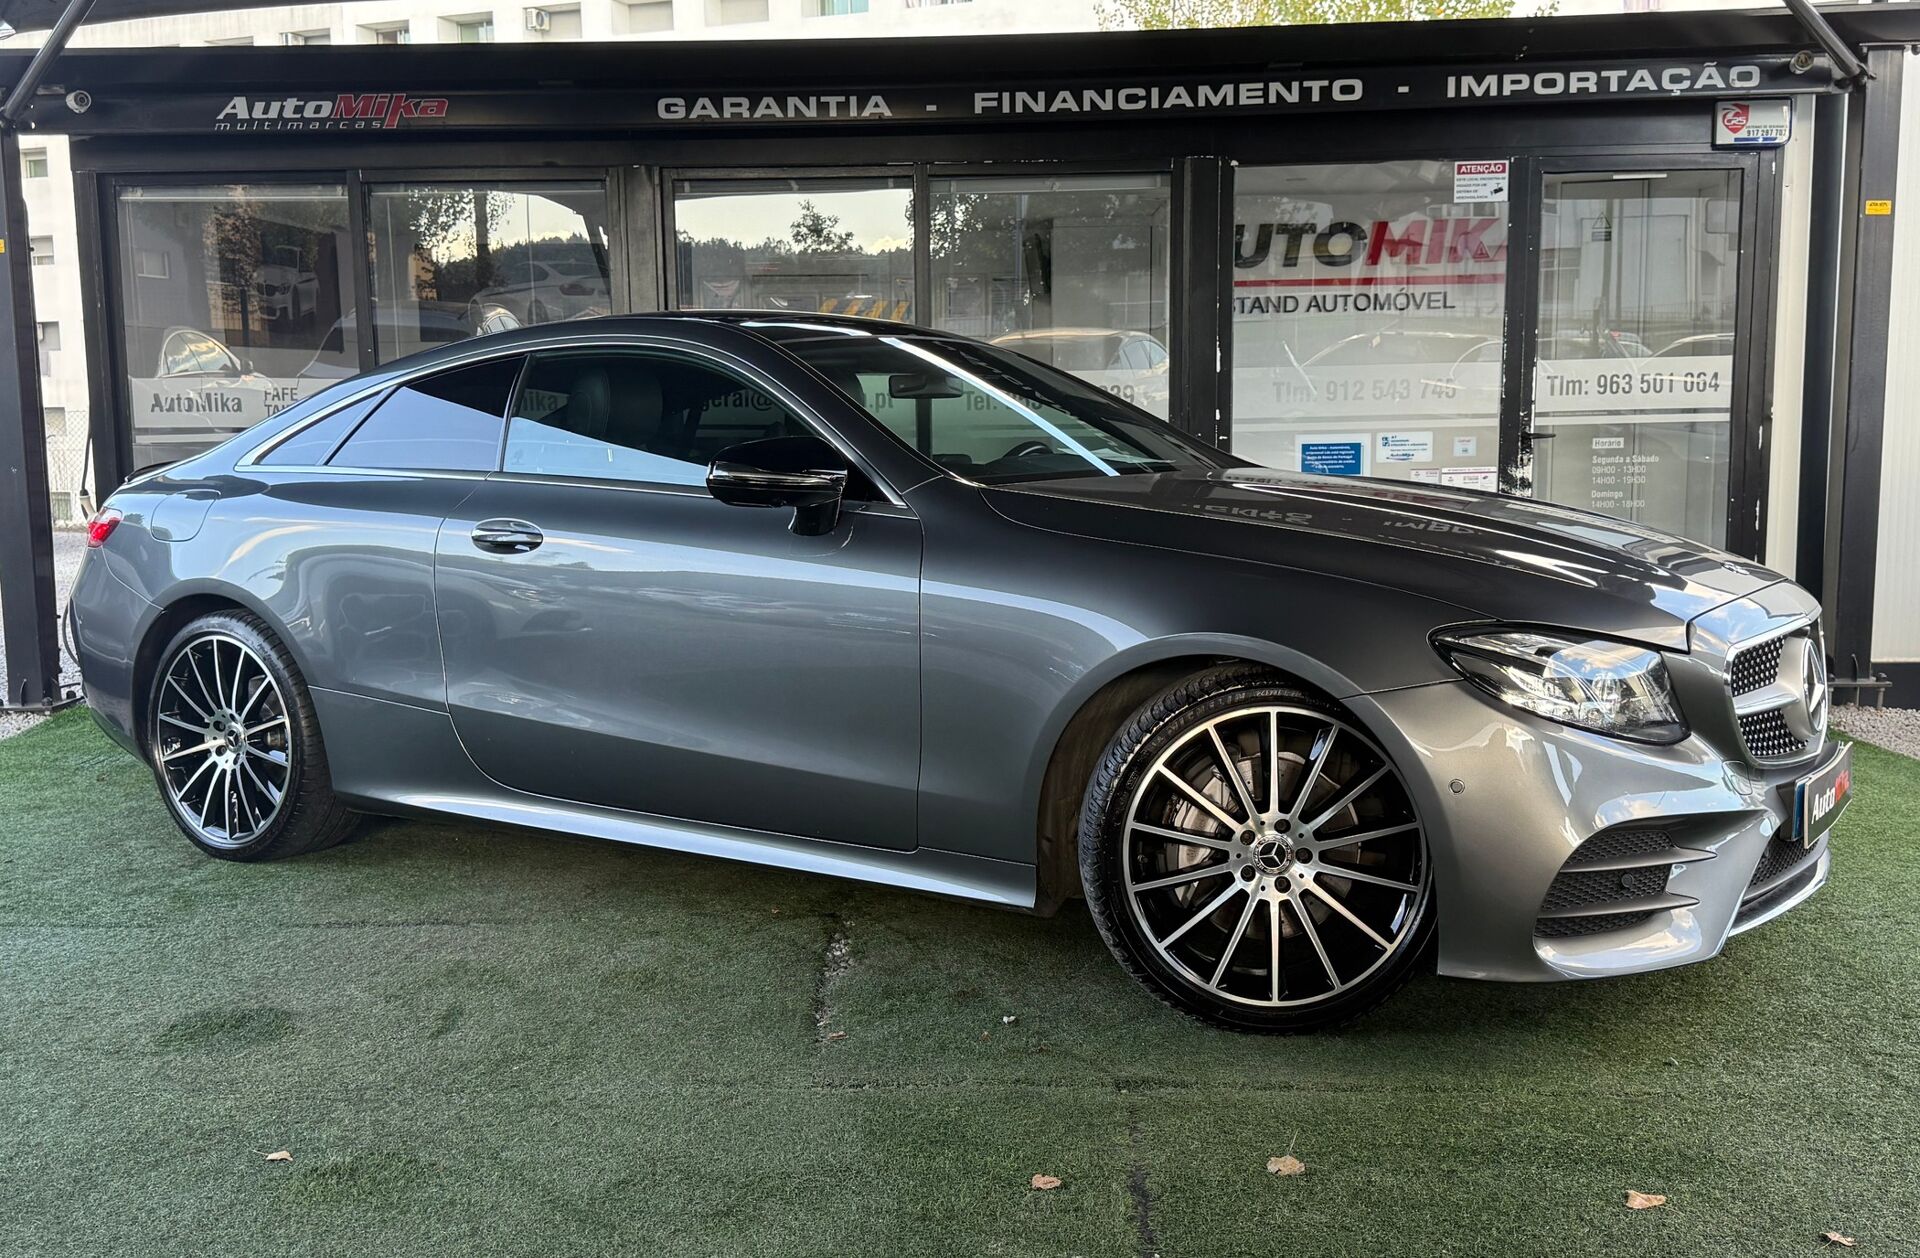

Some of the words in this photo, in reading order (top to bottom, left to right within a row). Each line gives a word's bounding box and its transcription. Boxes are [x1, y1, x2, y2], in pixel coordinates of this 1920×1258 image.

[657, 95, 893, 120] GARANTIA
[974, 78, 1364, 114] FINANCIAMENTO
[1447, 62, 1761, 98] IMPORTAÇÃO
[216, 93, 449, 129] AutoMika
[214, 120, 382, 131] multimarcas
[1460, 163, 1503, 174] ATENÇÃO
[1234, 218, 1506, 268] UTOMIK
[1233, 295, 1299, 315] TAND
[1306, 288, 1456, 313] AUTOMÓVEL
[1326, 380, 1365, 401] 912
[1372, 379, 1410, 400] 543
[1546, 375, 1589, 397] Tlm:
[1597, 374, 1633, 395] 963
[1640, 372, 1675, 394] 501
[264, 387, 298, 401] FAFE
[150, 392, 243, 413] AutoMika
[264, 404, 290, 417] TA
[1594, 439, 1622, 448] Horário
[1592, 455, 1624, 465] Segunda
[1632, 454, 1660, 463] Sábado
[1592, 466, 1616, 474] 09H00
[1591, 490, 1623, 499] Domingo
